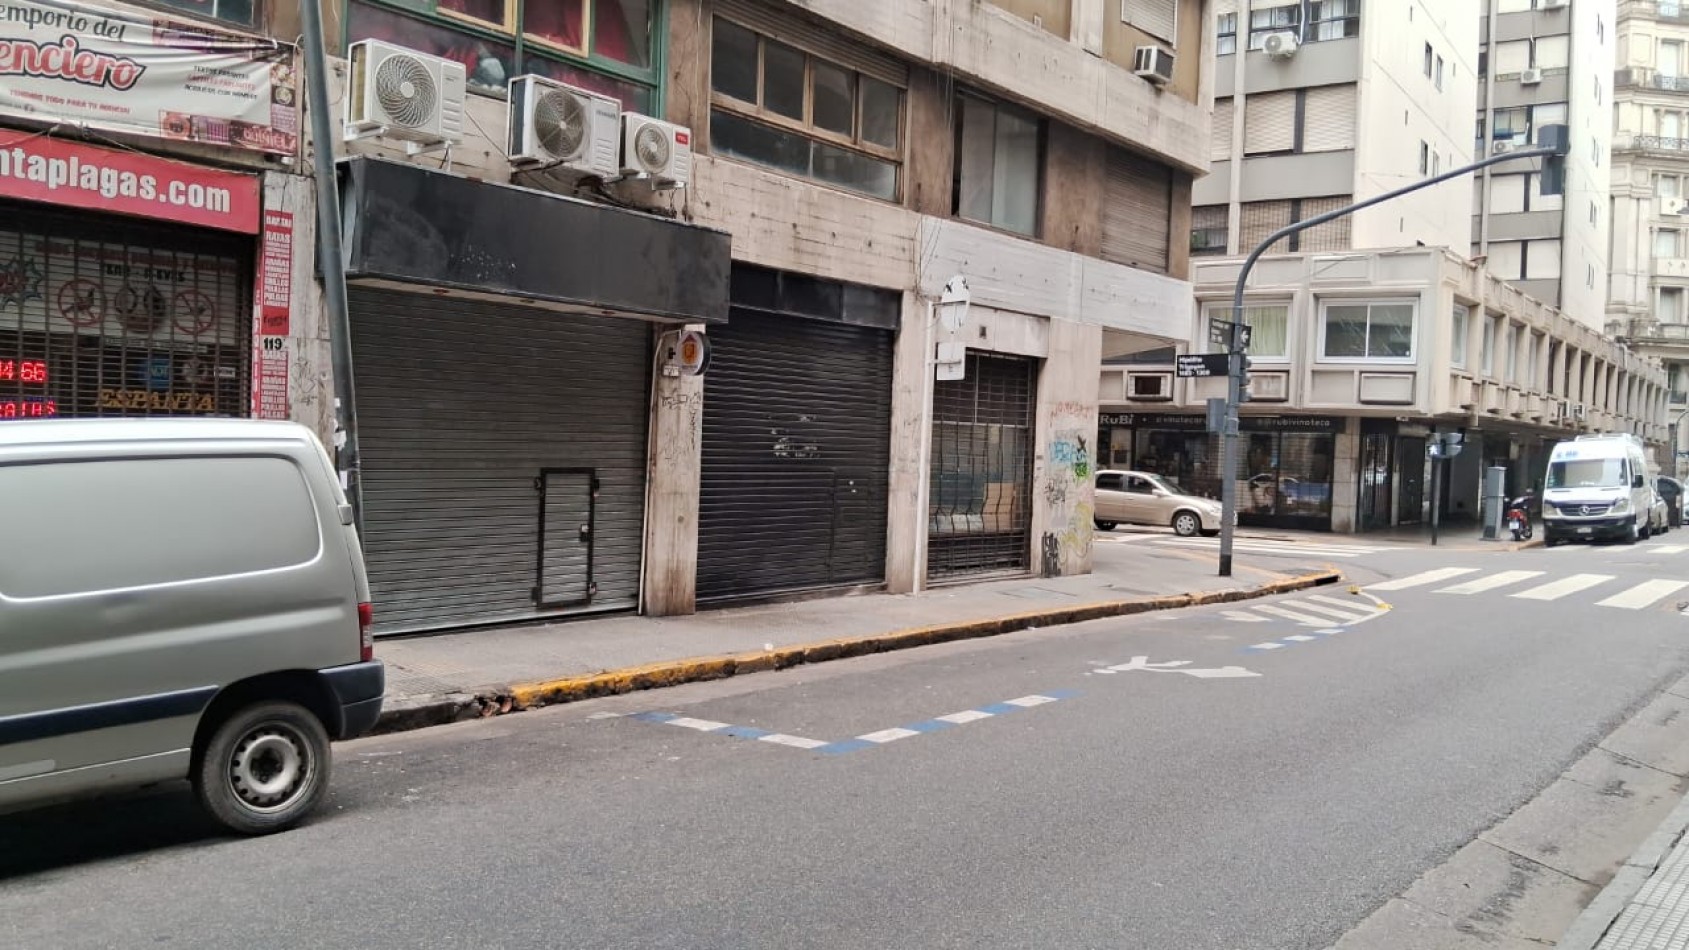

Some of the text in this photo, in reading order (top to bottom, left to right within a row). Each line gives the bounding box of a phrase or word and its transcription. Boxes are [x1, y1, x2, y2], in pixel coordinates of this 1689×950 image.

[93, 20, 126, 41] del
[266, 231, 291, 243] RATAS
[263, 338, 283, 350] 119
[96, 388, 217, 411] ESPANTA
